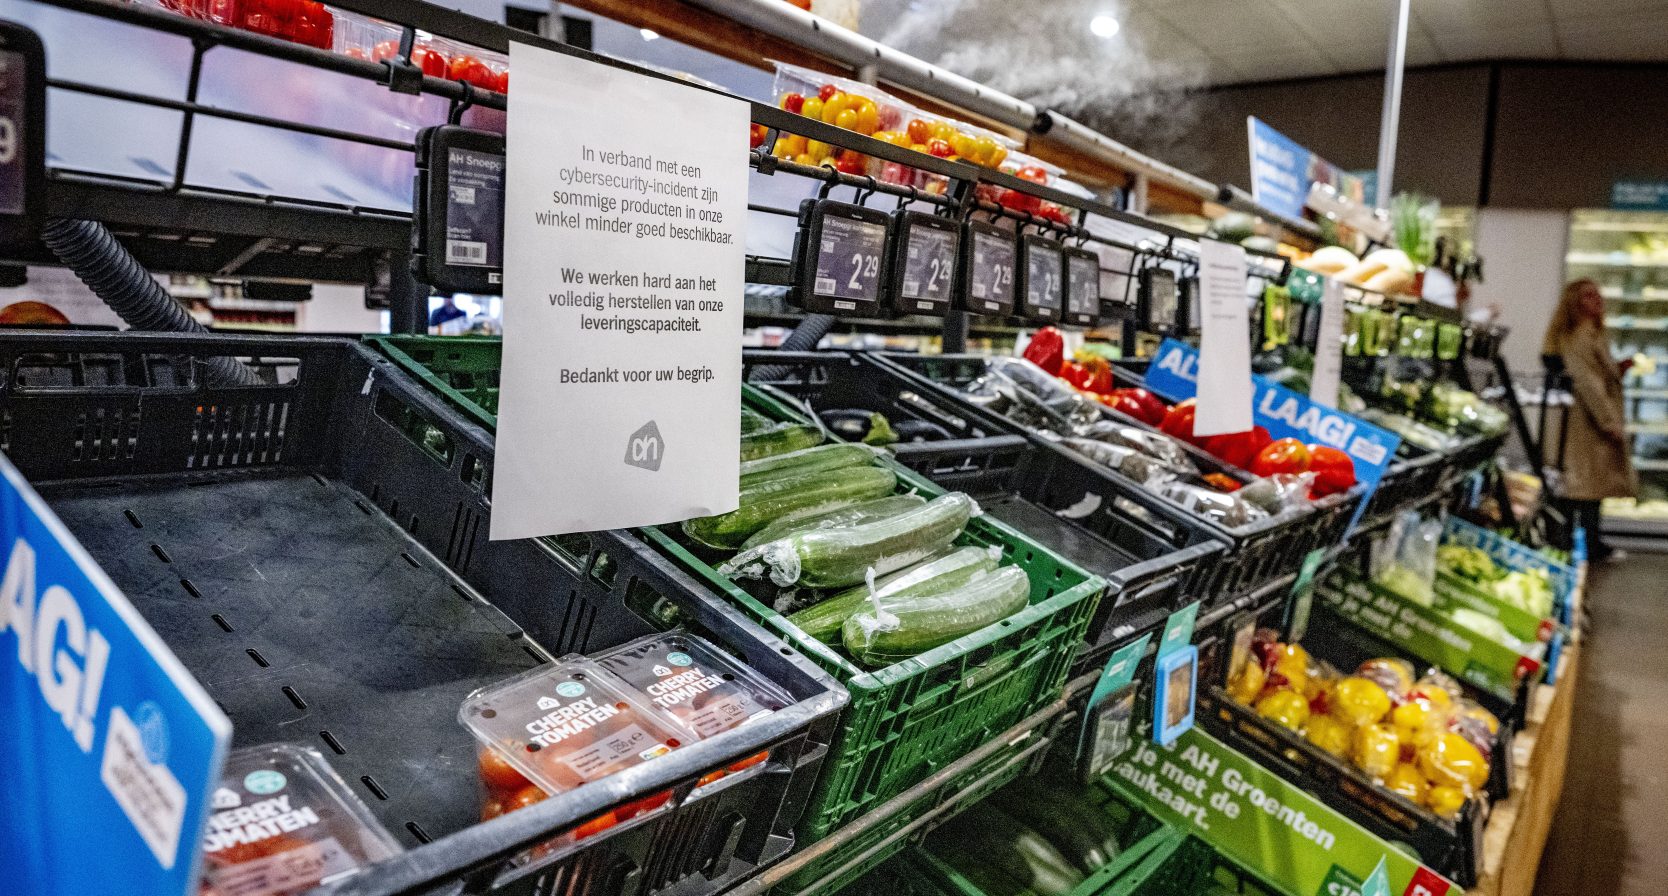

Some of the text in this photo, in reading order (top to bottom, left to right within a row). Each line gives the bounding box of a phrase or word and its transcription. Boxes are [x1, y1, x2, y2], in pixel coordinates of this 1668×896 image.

[582, 144, 701, 179] In verband met een
[559, 165, 719, 205] cybersecurity-incident zijn
[552, 190, 723, 224] sommige producten in onze
[535, 209, 734, 245] winkel minder goed beschikbaar.
[560, 267, 717, 292] We werken hard aan het
[548, 291, 725, 313] volledig herstellen van onze
[580, 313, 702, 335] leveringscapaciteit.
[559, 365, 715, 384] Bedankt voor uw begrip.
[647, 667, 705, 696] CHERRY
[652, 674, 726, 708] TOMATEN
[526, 696, 597, 735] CHERRY
[530, 703, 619, 747] TOMATEN
[1113, 762, 1210, 830] aukaart.
[1131, 740, 1157, 767] je
[1161, 761, 1207, 798] met
[1210, 792, 1241, 819] de
[1181, 745, 1336, 851] AH Groenten
